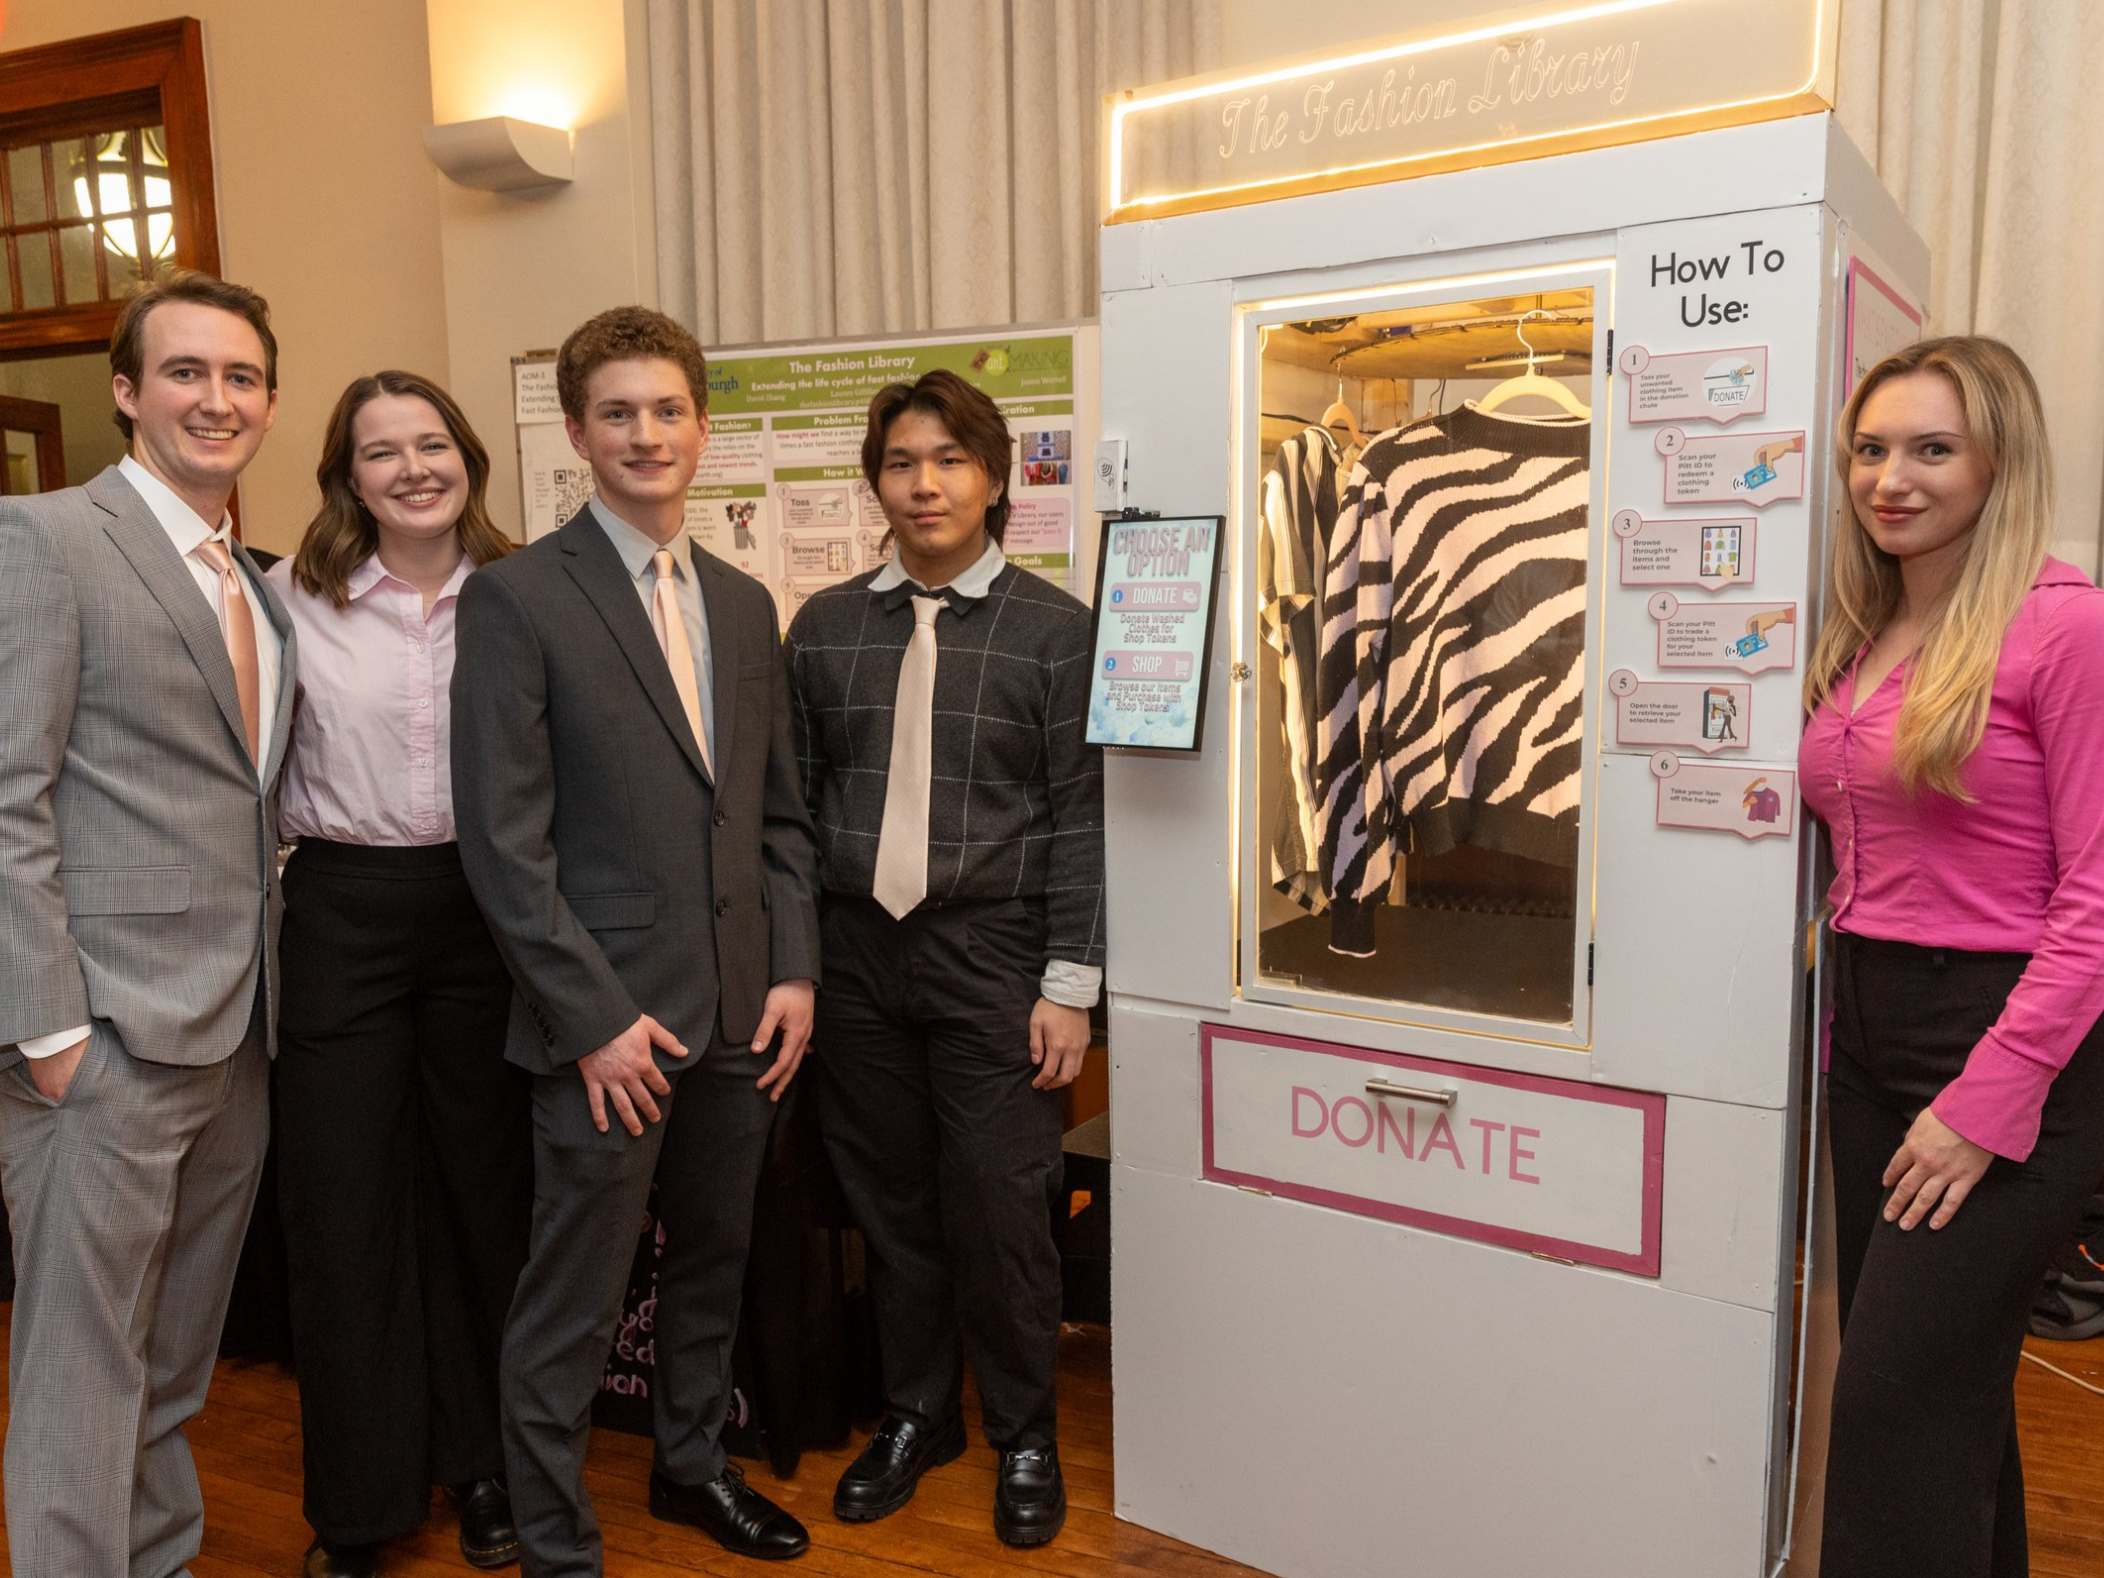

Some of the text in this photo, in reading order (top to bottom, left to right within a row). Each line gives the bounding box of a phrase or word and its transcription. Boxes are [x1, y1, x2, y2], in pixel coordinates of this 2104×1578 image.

[1219, 38, 1640, 159] The Fashion Library
[1651, 240, 1785, 288] How To
[1681, 293, 1750, 328] Use:
[789, 354, 916, 374] The Fashion Library
[1632, 354, 1637, 365] 1
[751, 380, 796, 391] Extending
[798, 377, 813, 389] the
[815, 376, 829, 388] life
[832, 376, 853, 389] cycle
[856, 374, 866, 386] of
[867, 373, 885, 385] fast
[1655, 373, 1671, 381] your
[521, 383, 534, 392] The
[1640, 380, 1673, 388] unwanted
[1640, 387, 1667, 395] clothing
[521, 395, 556, 404] Extending
[1713, 391, 1744, 403] DONATE
[521, 406, 536, 415] Fast
[813, 415, 852, 427] Problem
[722, 435, 735, 443] large
[792, 430, 809, 440] might
[1666, 434, 1674, 447] 2
[803, 440, 814, 448] fast
[815, 440, 837, 448] fashion
[838, 439, 862, 447] clothing
[710, 452, 740, 460] low-quality
[741, 451, 763, 459] clothing
[826, 449, 850, 457] reaches
[1698, 453, 1717, 461] your
[823, 468, 846, 478] How
[847, 467, 854, 476] it
[1678, 470, 1708, 478] redeem
[1677, 478, 1710, 486] clothing
[686, 487, 733, 497] Motivation
[790, 498, 811, 508] Toss
[1044, 519, 1059, 527] good
[1622, 518, 1631, 530] 3
[1113, 525, 1210, 556] CHOOSE AN
[791, 546, 826, 555] Browse
[1633, 547, 1663, 556] through
[1014, 555, 1043, 566] Goals
[1126, 549, 1191, 578] OPTION
[1132, 587, 1178, 604] DONATE
[1658, 600, 1667, 611] 4
[1120, 613, 1185, 624] Donate Washed
[1128, 623, 1175, 634] Clothes for
[1123, 633, 1177, 645] Shop Tokens
[1132, 656, 1163, 673] SHOP
[1108, 681, 1139, 692] Browse
[1140, 683, 1156, 693] our
[1619, 677, 1627, 690] 5
[1106, 691, 1122, 702] and
[1123, 692, 1161, 703] Purchase
[1115, 701, 1170, 713] Shop Tokens
[1629, 702, 1648, 710] Open
[1660, 759, 1669, 771] 6
[1694, 797, 1719, 805] hanger
[1291, 1085, 1541, 1185] DONATE
